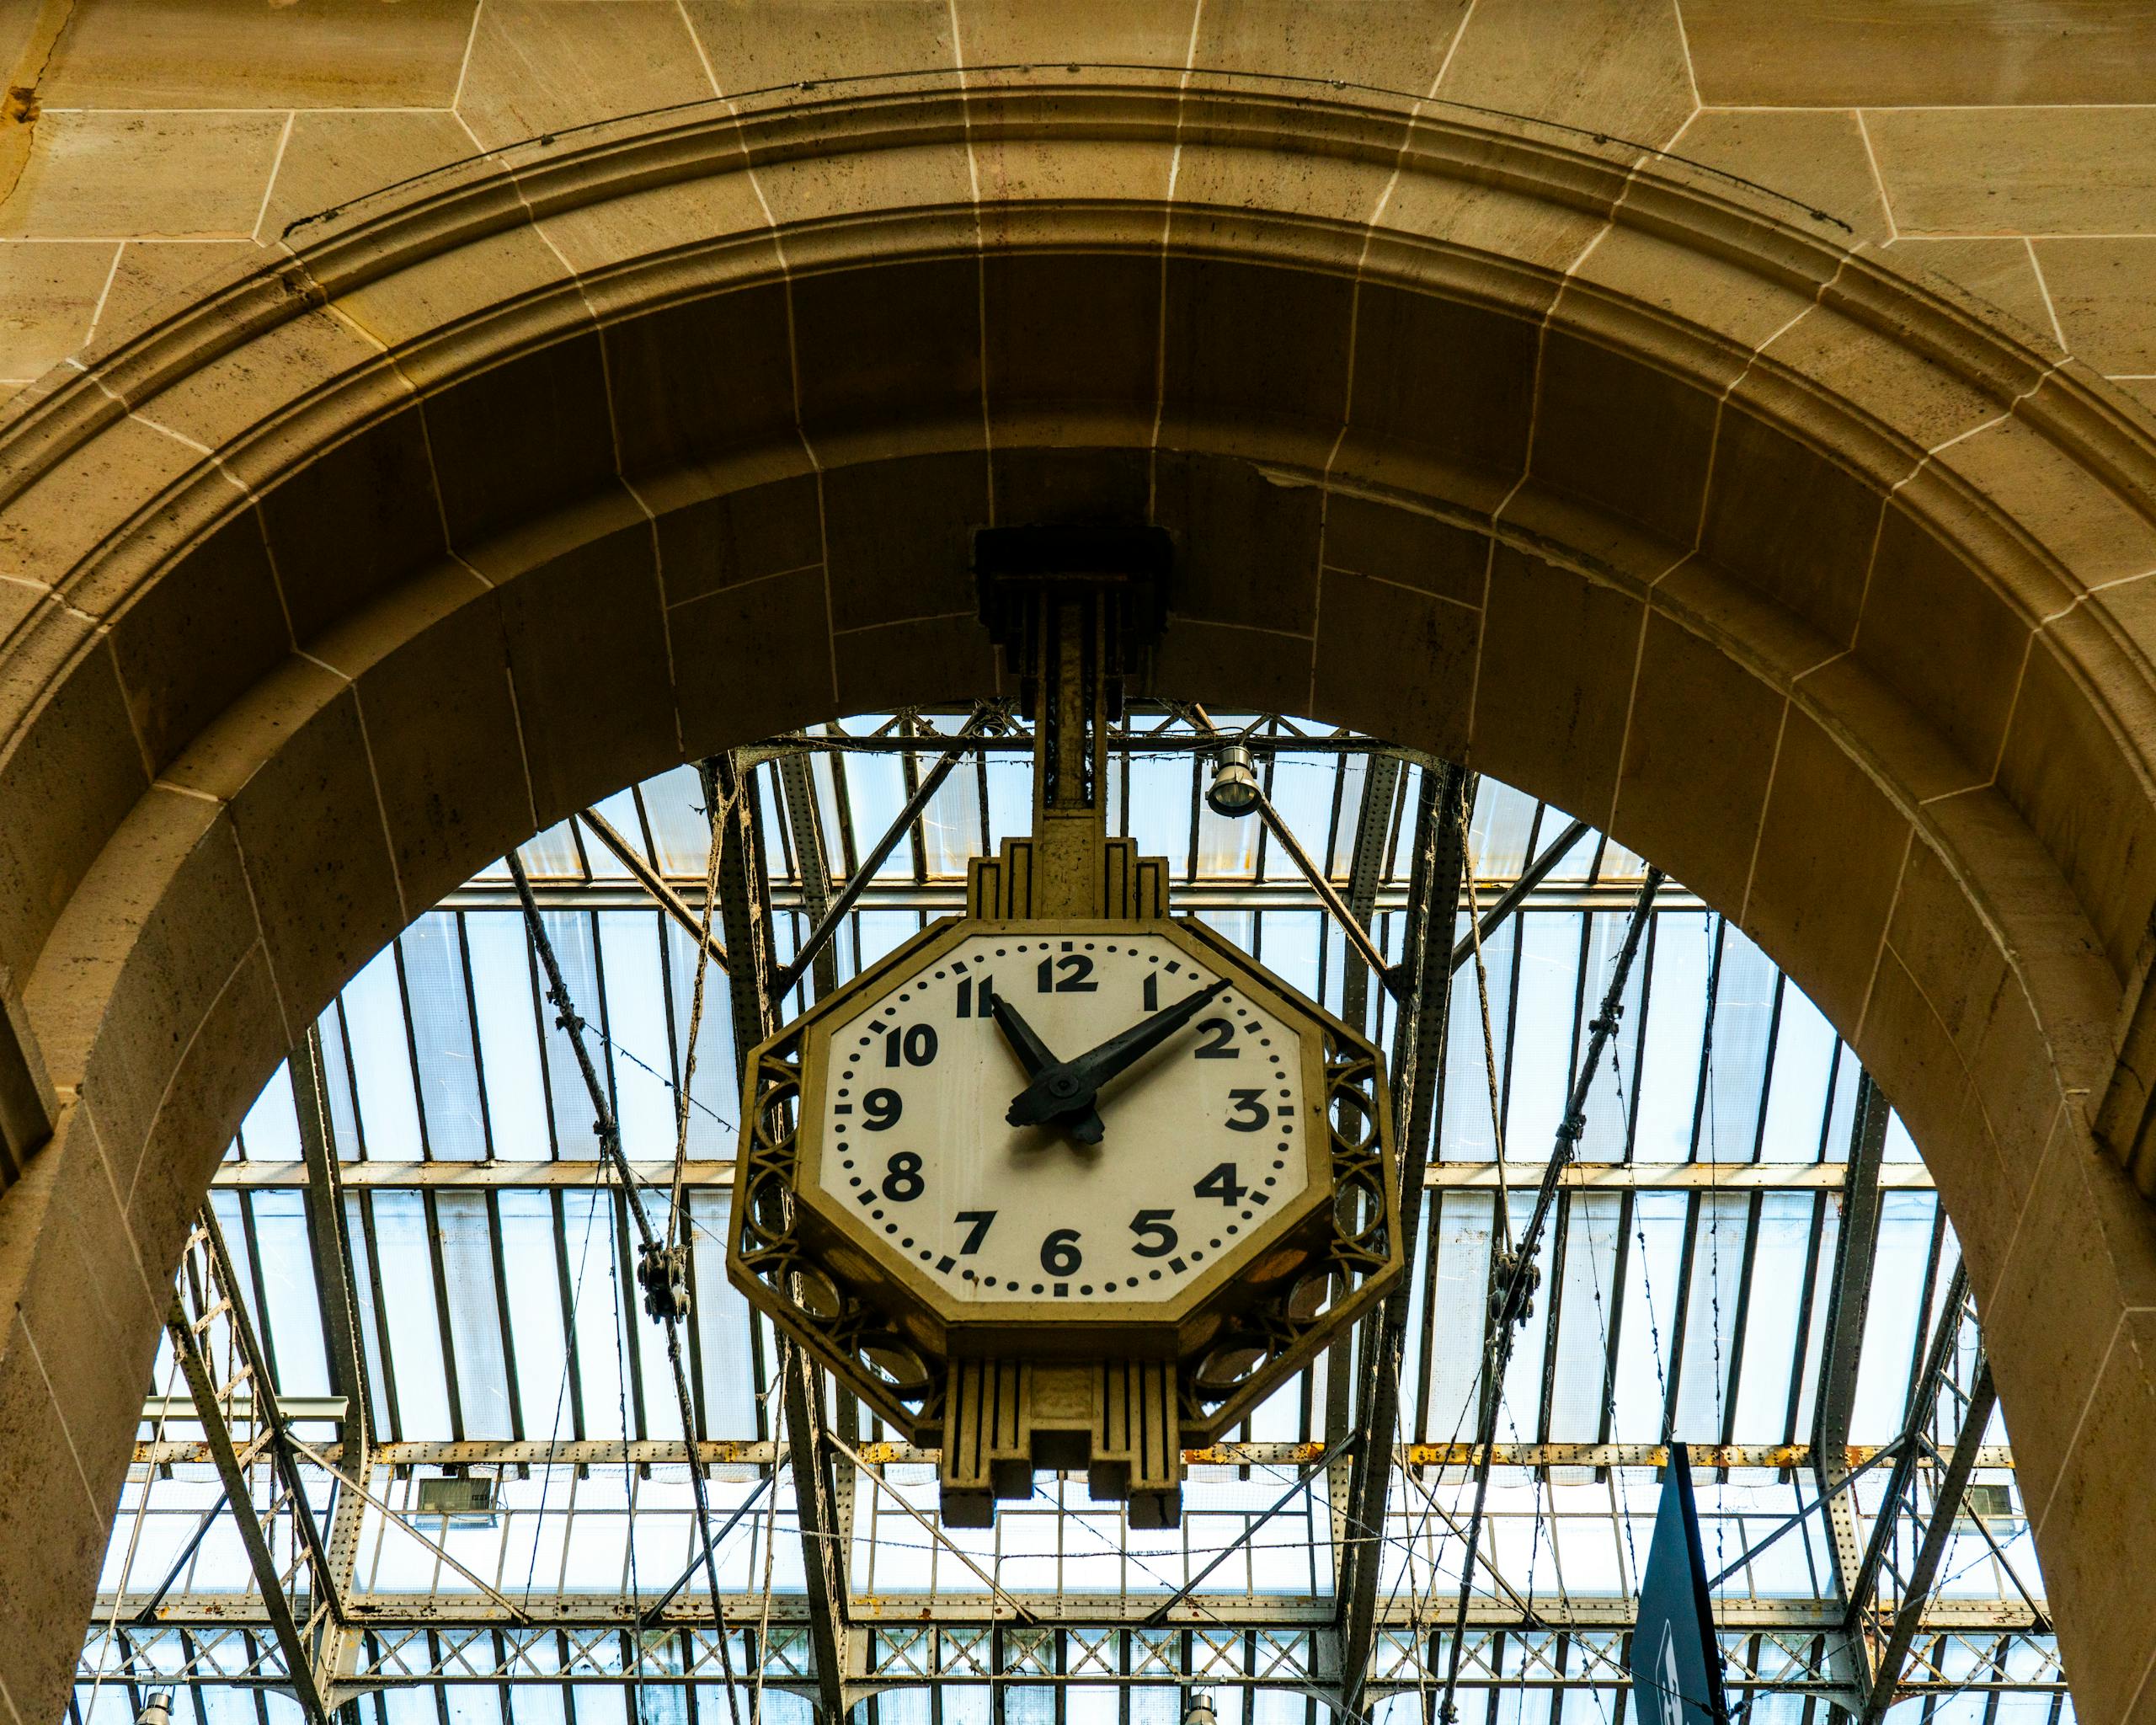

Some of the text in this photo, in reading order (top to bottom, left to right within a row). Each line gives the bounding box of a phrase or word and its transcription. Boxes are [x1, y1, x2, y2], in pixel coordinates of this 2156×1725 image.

[956, 974, 993, 1018] 11
[1037, 953, 1099, 994] 12
[1143, 970, 1159, 1012] 1
[884, 1023, 939, 1068] 10
[1193, 1017, 1241, 1060] 2
[861, 1087, 903, 1132] 9
[1224, 1088, 1270, 1133] 3
[881, 1151, 926, 1203] 8
[1193, 1162, 1249, 1207] 4
[953, 1210, 999, 1255] 7
[1039, 1228, 1083, 1278] 6
[1128, 1209, 1179, 1258] 5
